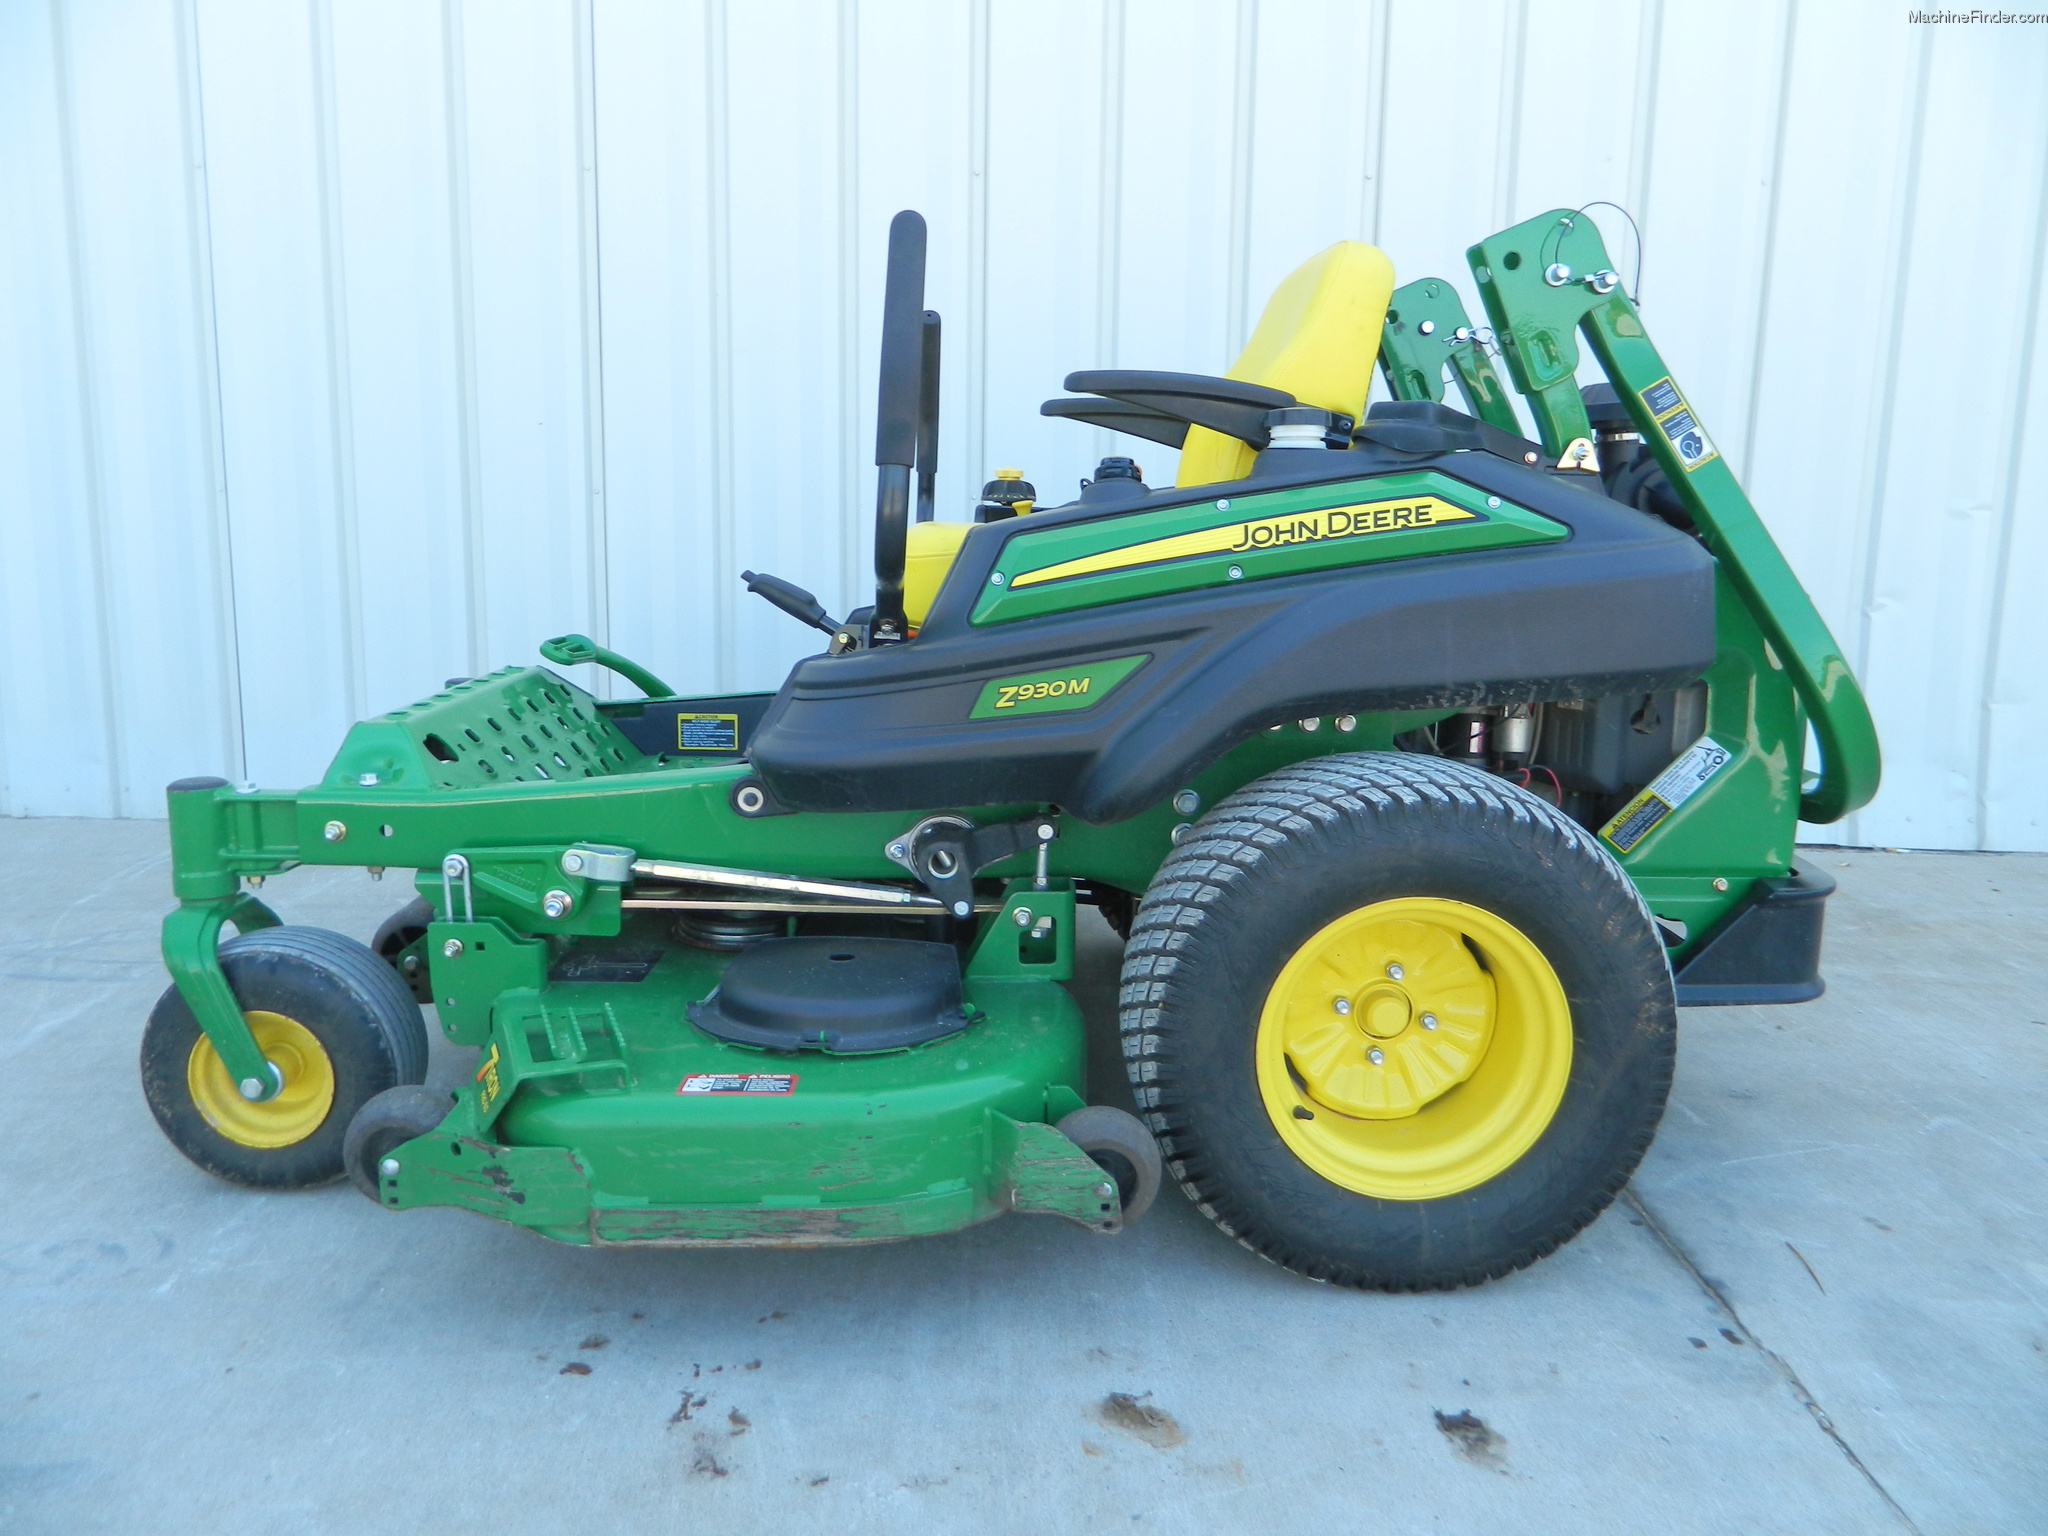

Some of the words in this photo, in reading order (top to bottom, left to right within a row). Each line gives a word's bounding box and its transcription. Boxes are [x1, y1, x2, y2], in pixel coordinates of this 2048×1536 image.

[1232, 518, 1318, 549] JOHN
[1327, 503, 1433, 536] DEERE
[993, 677, 1092, 709] Z930M
